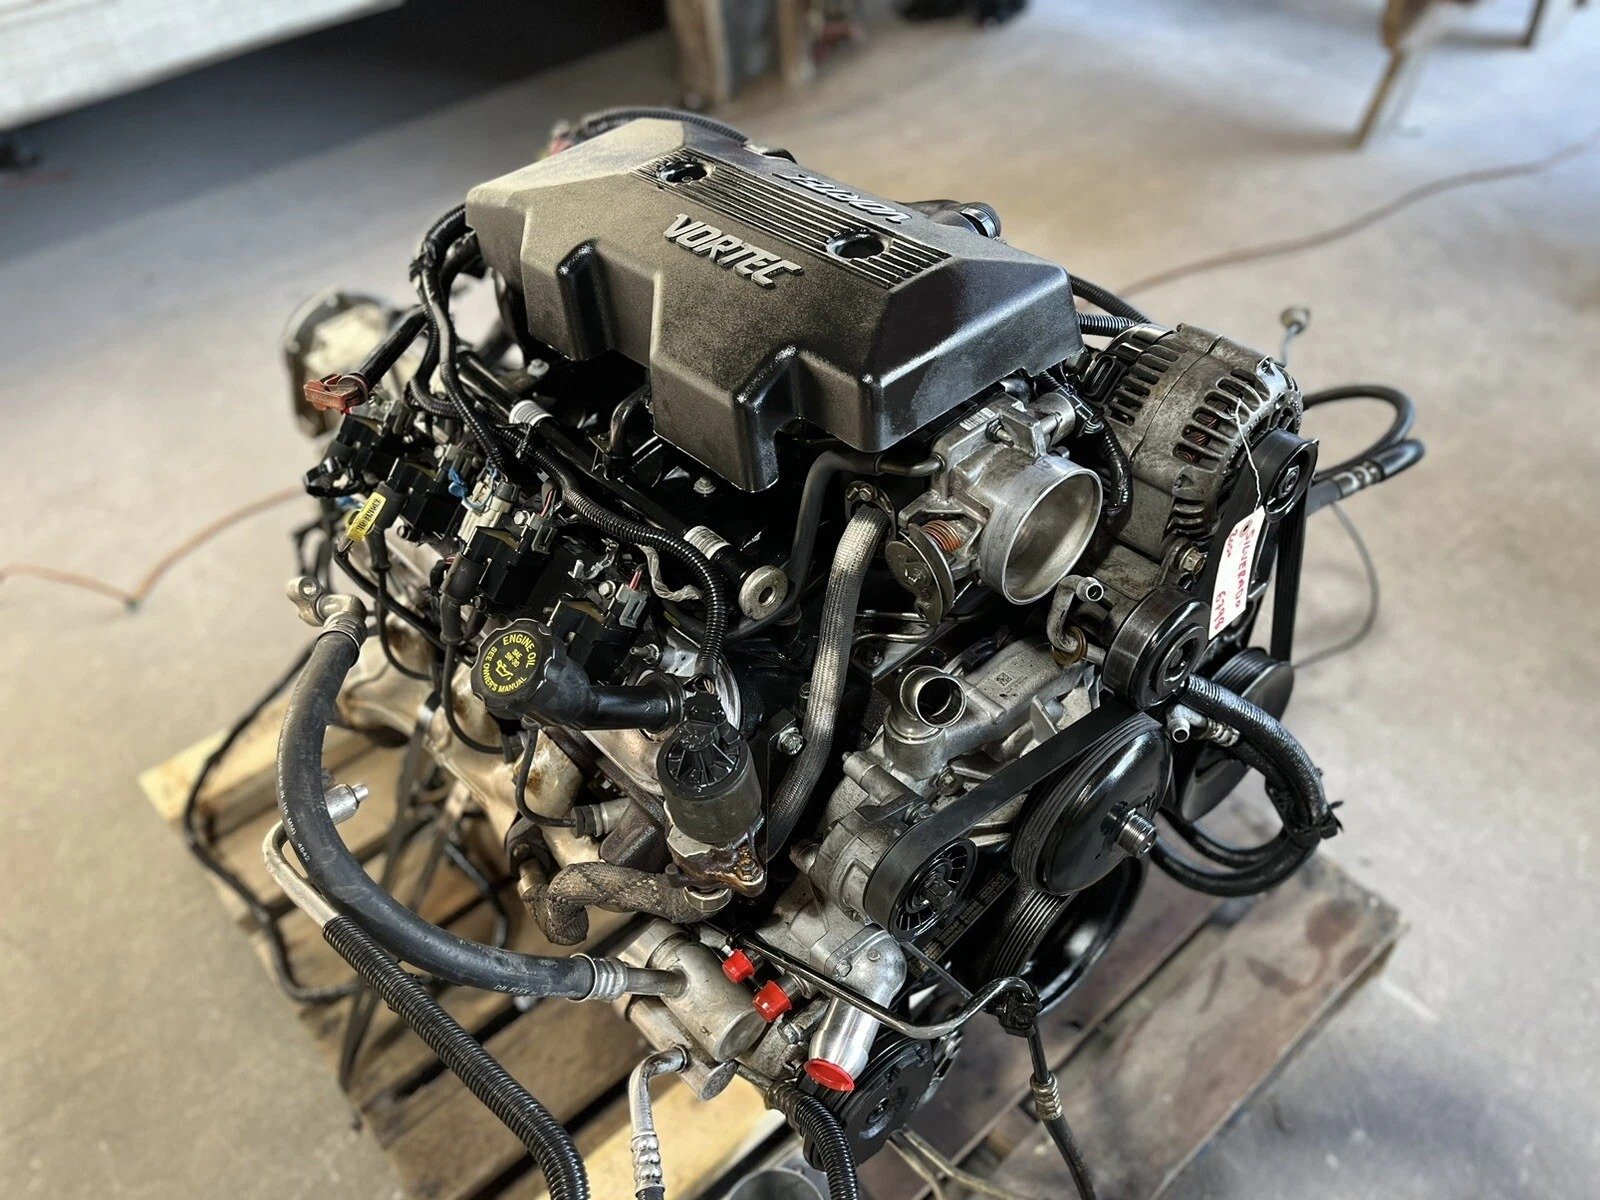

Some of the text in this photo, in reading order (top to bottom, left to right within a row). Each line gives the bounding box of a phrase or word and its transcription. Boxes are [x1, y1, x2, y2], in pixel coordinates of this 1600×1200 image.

[663, 212, 804, 289] VORTEC
[484, 646, 498, 662] SEE
[497, 676, 528, 693] MANUAL
[502, 633, 537, 669] ENGINE OIL
